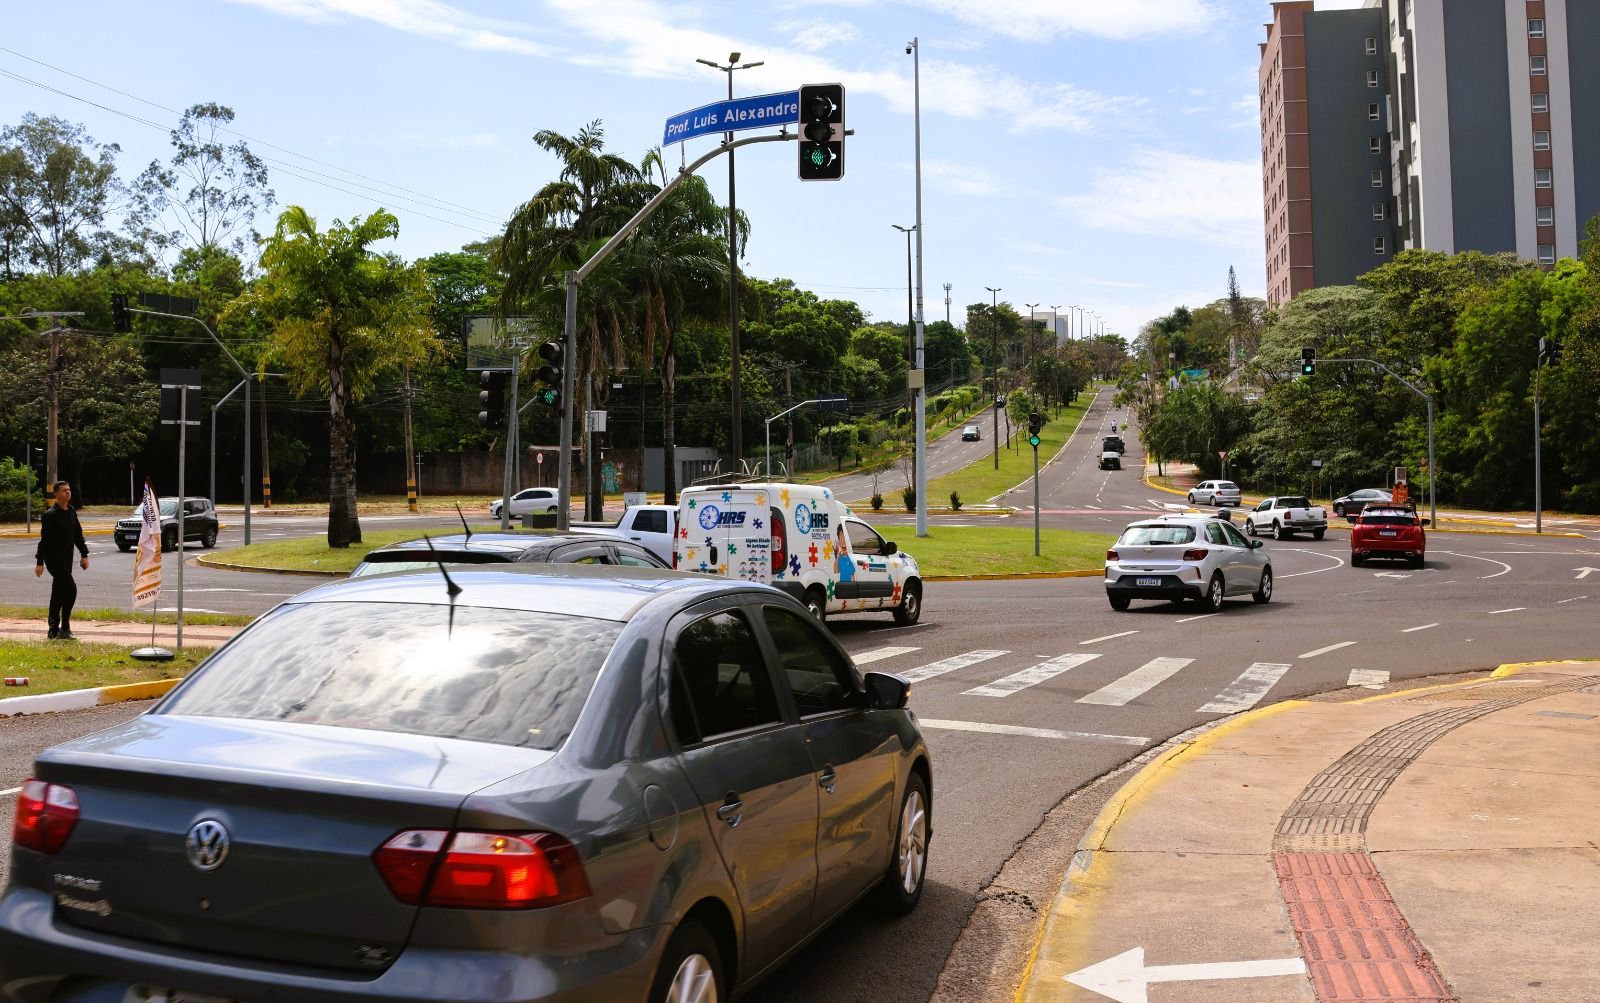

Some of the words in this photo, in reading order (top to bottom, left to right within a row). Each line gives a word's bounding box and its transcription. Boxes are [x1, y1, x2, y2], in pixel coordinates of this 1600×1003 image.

[667, 121, 690, 137] Prof.
[693, 112, 718, 129] Luis
[724, 101, 797, 124] Alexandre
[717, 511, 746, 524] HRS
[811, 513, 829, 528] HRS
